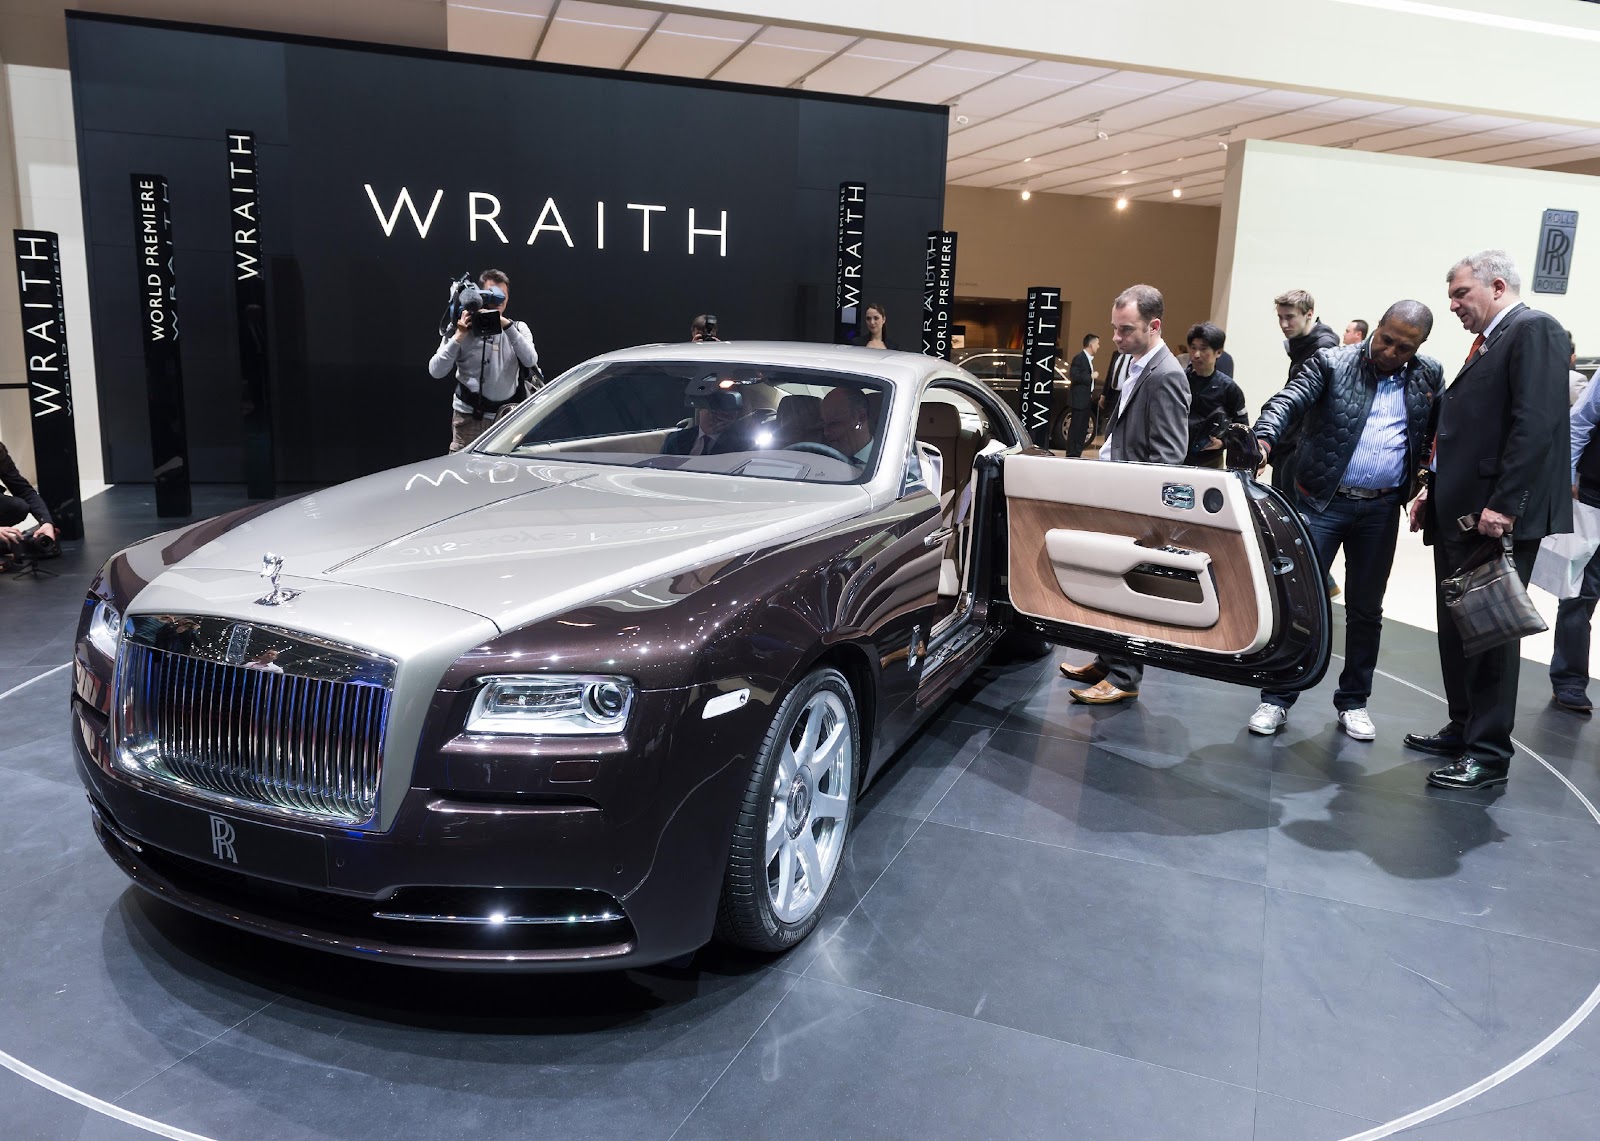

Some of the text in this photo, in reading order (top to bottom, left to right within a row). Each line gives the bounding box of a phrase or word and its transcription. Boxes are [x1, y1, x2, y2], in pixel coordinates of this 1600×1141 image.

[139, 180, 165, 341] WORLD PREMIERE
[161, 182, 179, 341] WRAITH
[228, 134, 259, 281] WRAITH
[364, 183, 727, 257] WRAITH
[843, 186, 864, 309] WRAITH
[939, 236, 952, 305] PREMIERE
[1547, 212, 1576, 225] ROLLS
[17, 236, 62, 417] WRAITH
[51, 239, 72, 417] WORLD PREMIERE
[1537, 279, 1567, 291] ROYCE
[1021, 292, 1037, 427] WORLD PREMIERE
[1031, 292, 1058, 429] WRAITH
